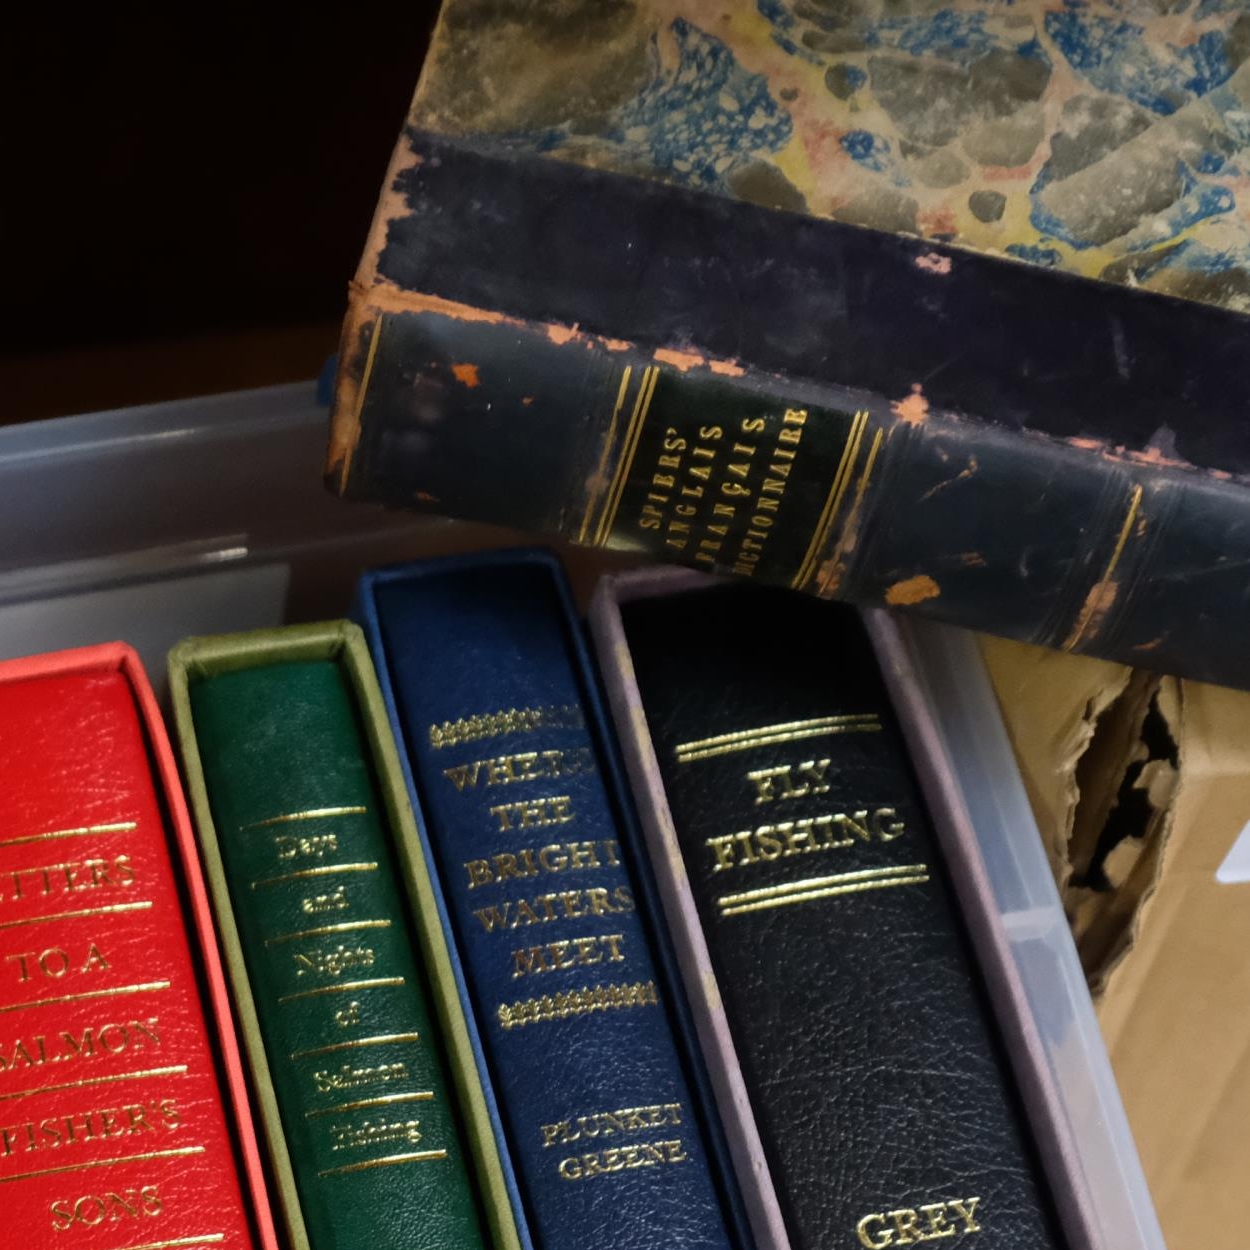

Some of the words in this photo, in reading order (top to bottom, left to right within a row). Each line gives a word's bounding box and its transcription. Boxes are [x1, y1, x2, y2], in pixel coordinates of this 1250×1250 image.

[666, 426, 723, 549] ANGLAIS
[695, 418, 766, 563] FRANÇAIS
[748, 758, 831, 803] FLY
[490, 795, 577, 832] THE
[275, 834, 338, 860] Days
[705, 808, 905, 873] FISHING
[463, 839, 621, 890] BRIGHT
[302, 885, 349, 913] and
[472, 886, 636, 934] WATERS
[4, 946, 70, 983] TO
[81, 943, 110, 973] A
[293, 945, 375, 976] Nights
[510, 933, 625, 979] MEET
[334, 1001, 360, 1026] of
[313, 1062, 409, 1093] Salmon
[540, 1102, 682, 1148] PLUNKET
[558, 1139, 687, 1182] GREENE
[50, 1185, 165, 1231] SONS
